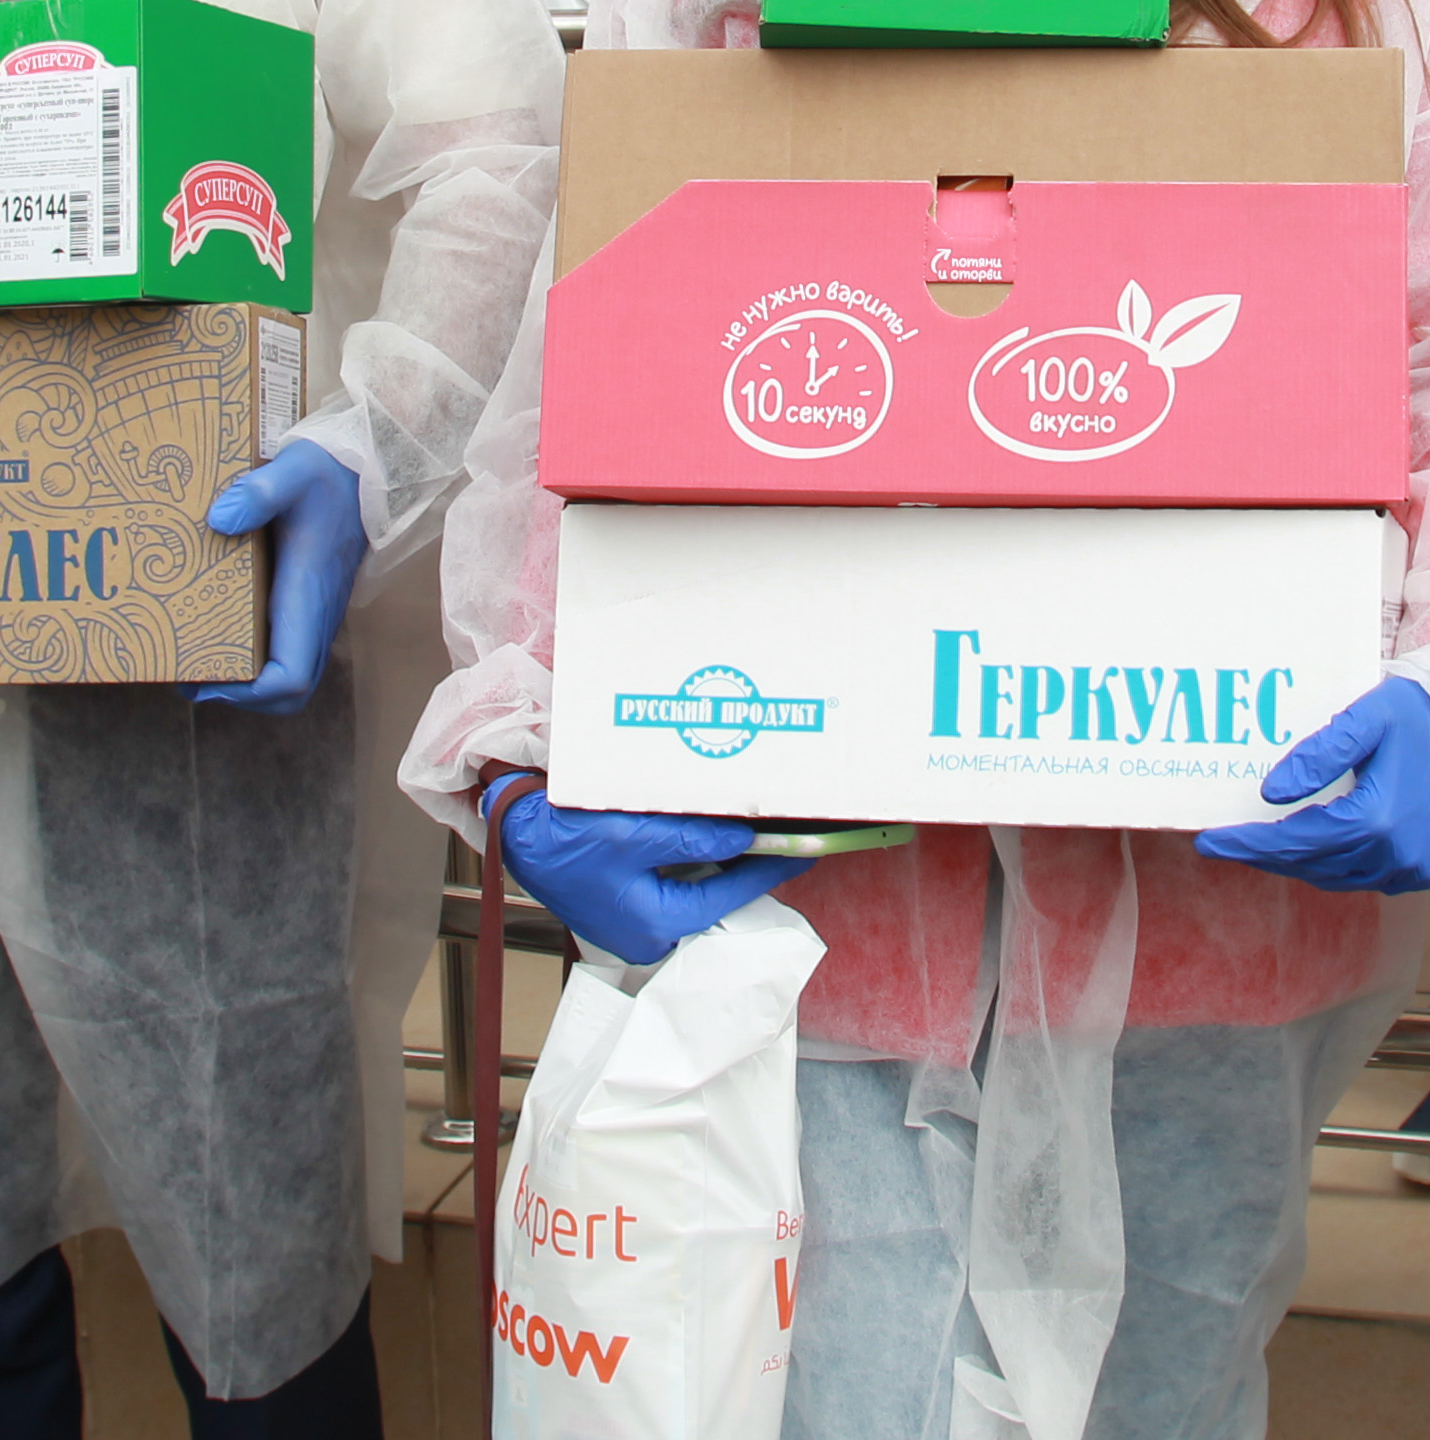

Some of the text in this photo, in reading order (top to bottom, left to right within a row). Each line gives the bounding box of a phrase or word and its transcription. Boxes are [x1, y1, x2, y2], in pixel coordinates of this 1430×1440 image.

[14, 51, 86, 76] СУПЕРСУП
[194, 177, 264, 216] СУПЕРСУП
[938, 268, 1003, 283] и оторви
[951, 256, 1003, 271] потяни
[720, 280, 919, 352] не нужно варить!
[1020, 356, 1129, 405] 100%
[740, 377, 868, 430] 10 секунд
[1029, 410, 1117, 439] вкусно
[620, 695, 818, 728] РУССКИЙ ПРОДУКТ
[926, 751, 1274, 781] МОМЕНТАЛЬНАЯ ОВСЯНАЯ КАШ
